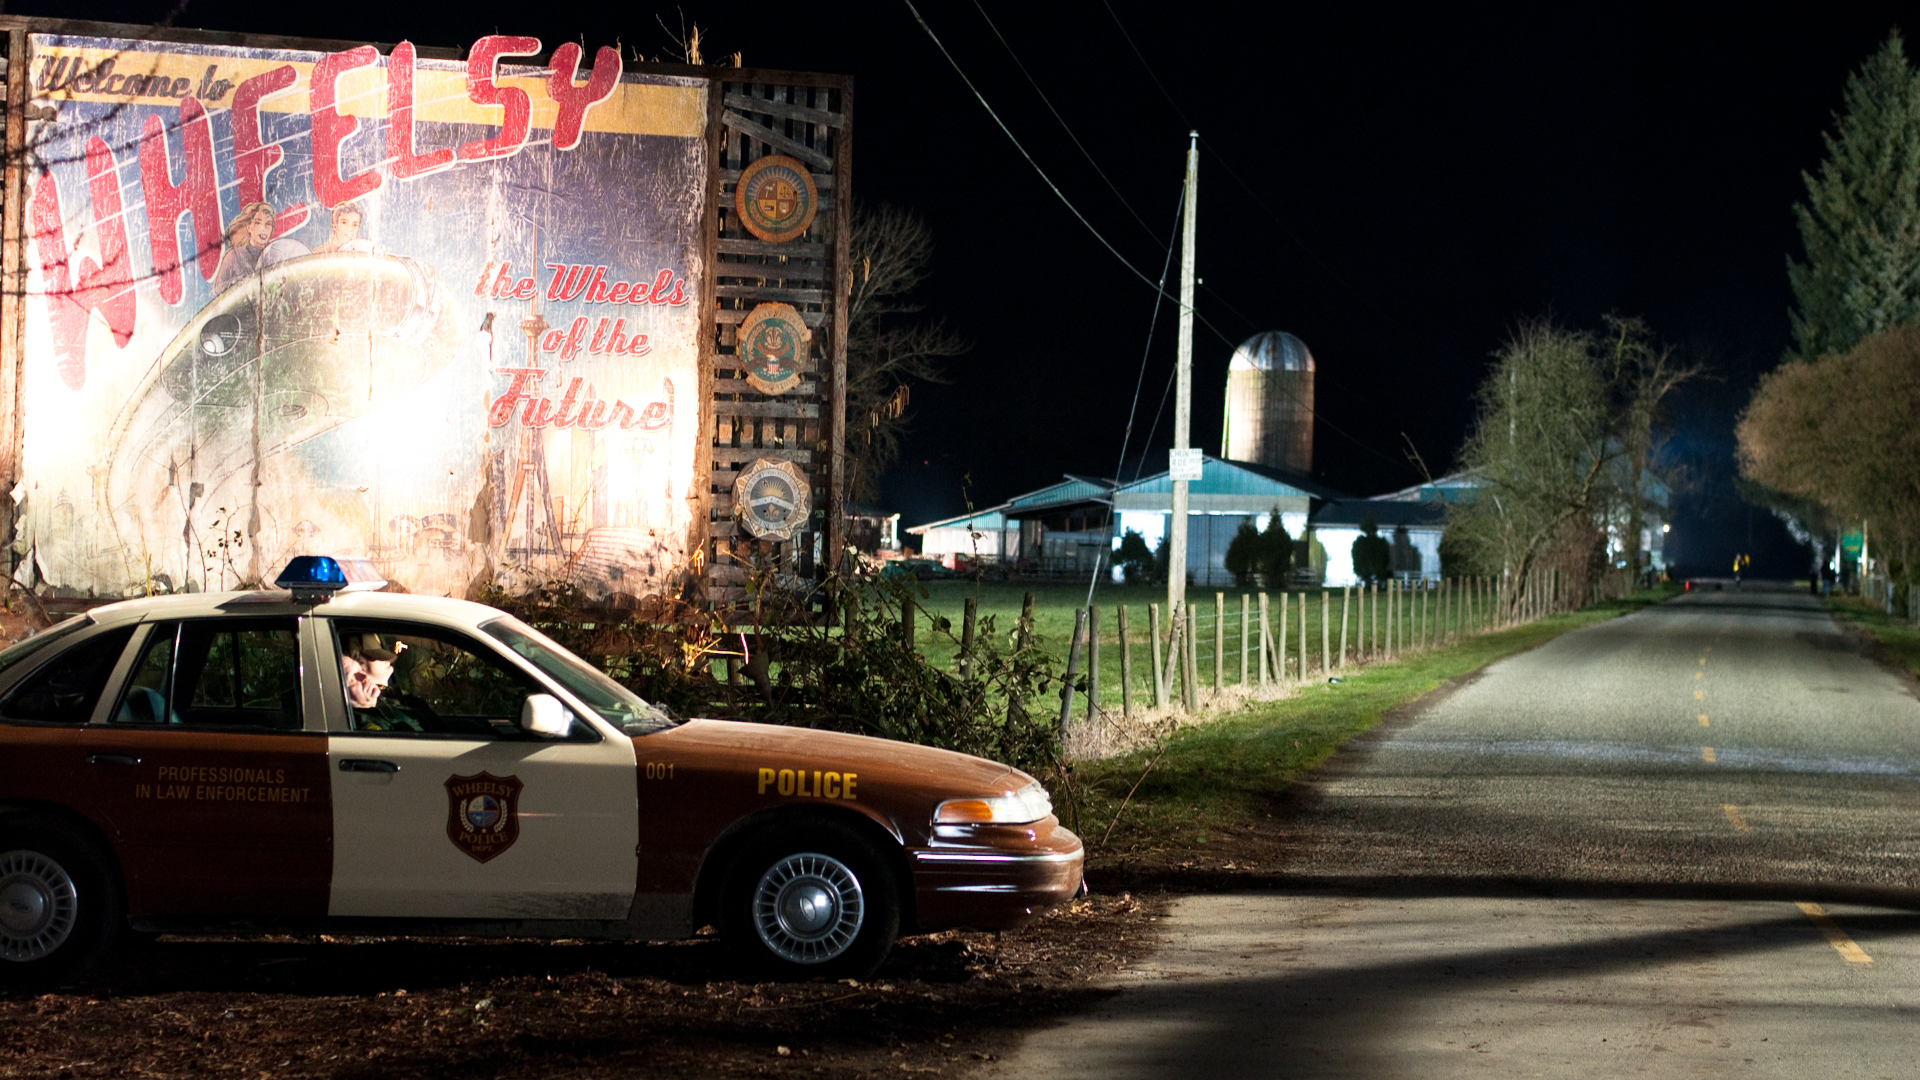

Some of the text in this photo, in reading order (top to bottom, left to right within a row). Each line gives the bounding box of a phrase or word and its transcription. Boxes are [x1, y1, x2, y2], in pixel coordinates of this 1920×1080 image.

[36, 54, 235, 101] Welcome to
[31, 35, 623, 391] WHEELSY
[474, 261, 689, 307] the Wheels
[541, 316, 651, 361] of the
[490, 367, 671, 431] Future
[158, 766, 285, 784] PROFESSIONALS
[646, 762, 674, 780] 001
[758, 768, 857, 799] POLICE
[135, 784, 310, 802] IN LAW ENFORCEMENT
[452, 782, 514, 797] WHEELSY
[459, 831, 508, 845] POLICE
